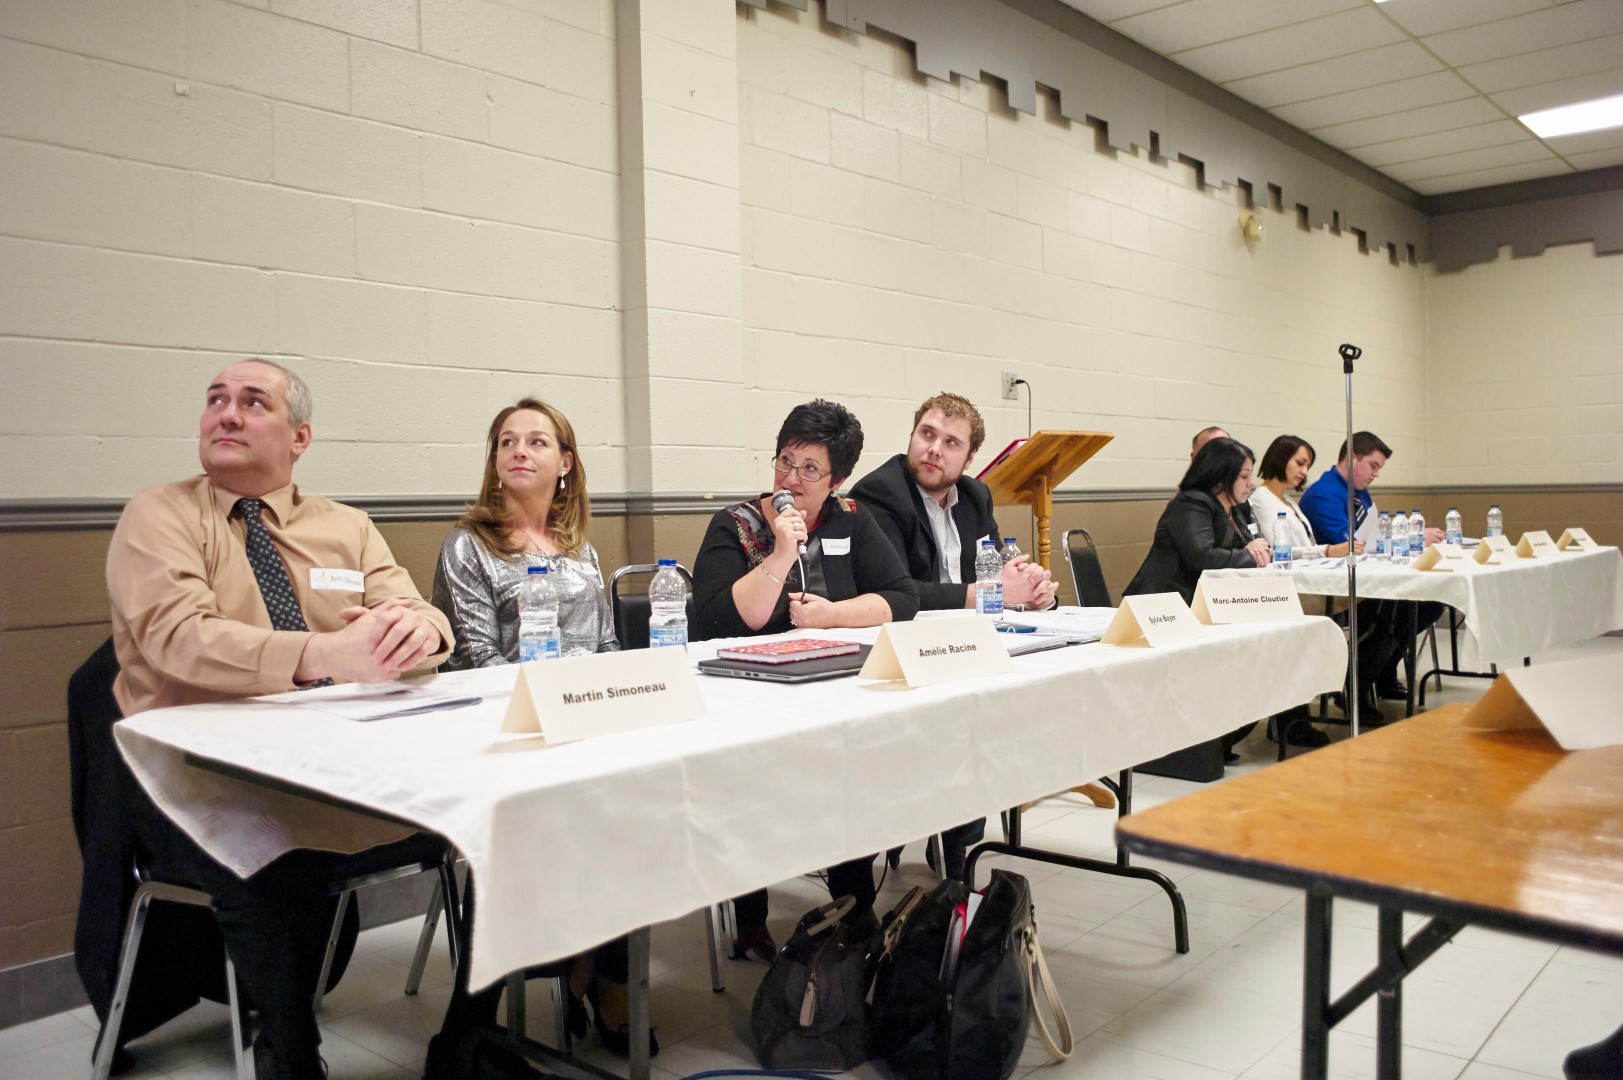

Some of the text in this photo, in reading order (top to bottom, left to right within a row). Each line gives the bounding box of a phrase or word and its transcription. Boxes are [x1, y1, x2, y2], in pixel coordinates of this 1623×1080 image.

[1212, 595, 1289, 604] Marc-Antoine Cloutier
[1149, 616, 1163, 625] Sylvie
[919, 643, 977, 657] Amélie Racine
[563, 682, 666, 705] Martin Simoneau
